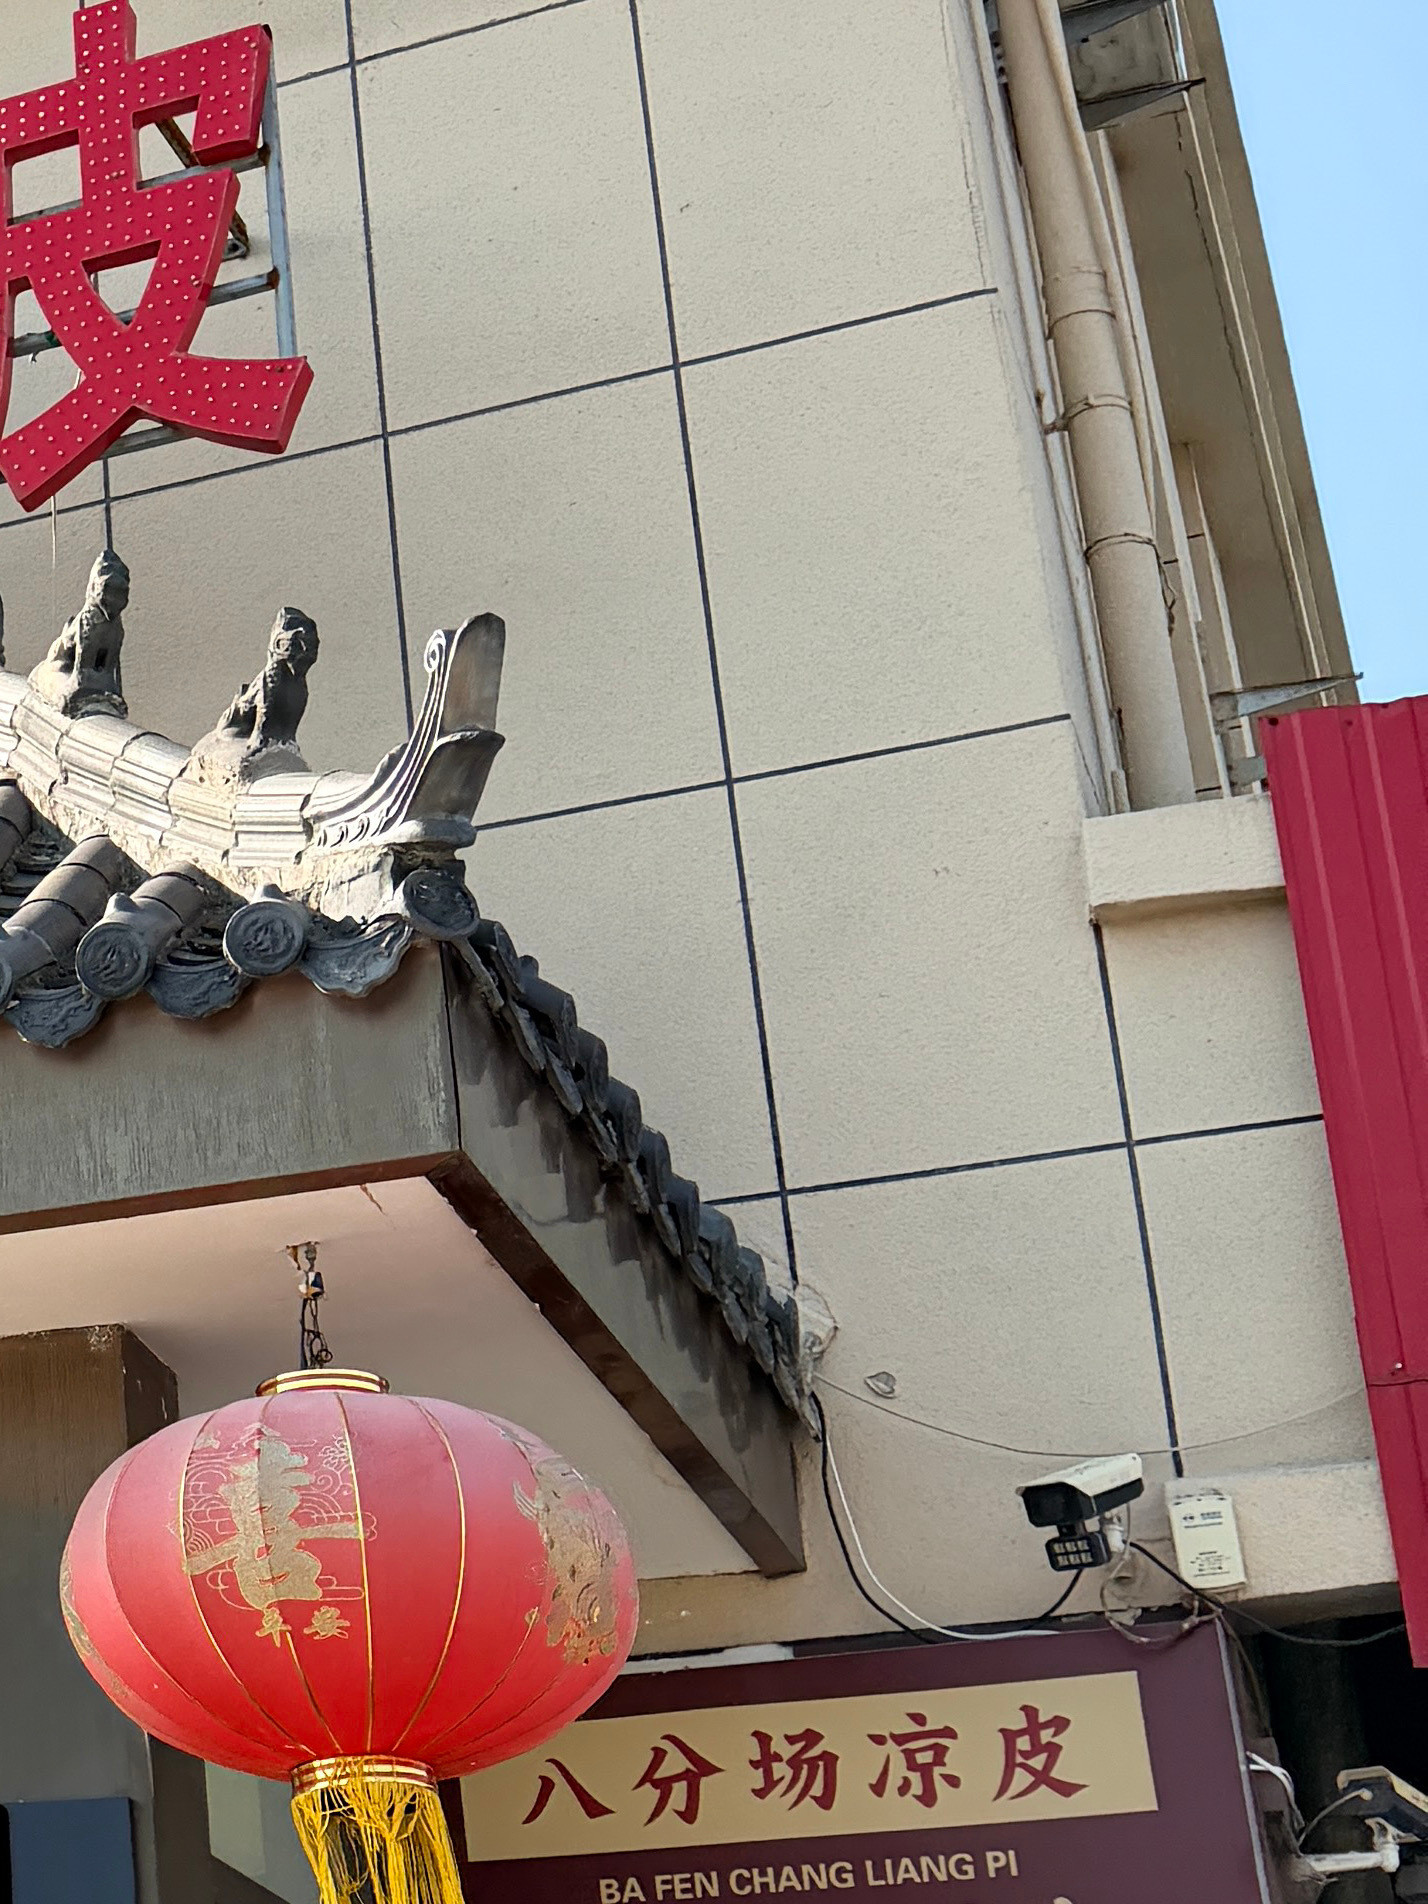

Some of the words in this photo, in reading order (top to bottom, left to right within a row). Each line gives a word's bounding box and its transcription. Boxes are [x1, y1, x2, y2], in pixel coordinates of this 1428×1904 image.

[521, 1704, 1089, 1827] 八分场凉皮
[654, 1869, 721, 1903] FEN
[728, 1859, 856, 1898] CHANG
[863, 1852, 977, 1891] LIANG
[986, 1849, 1020, 1881] PI
